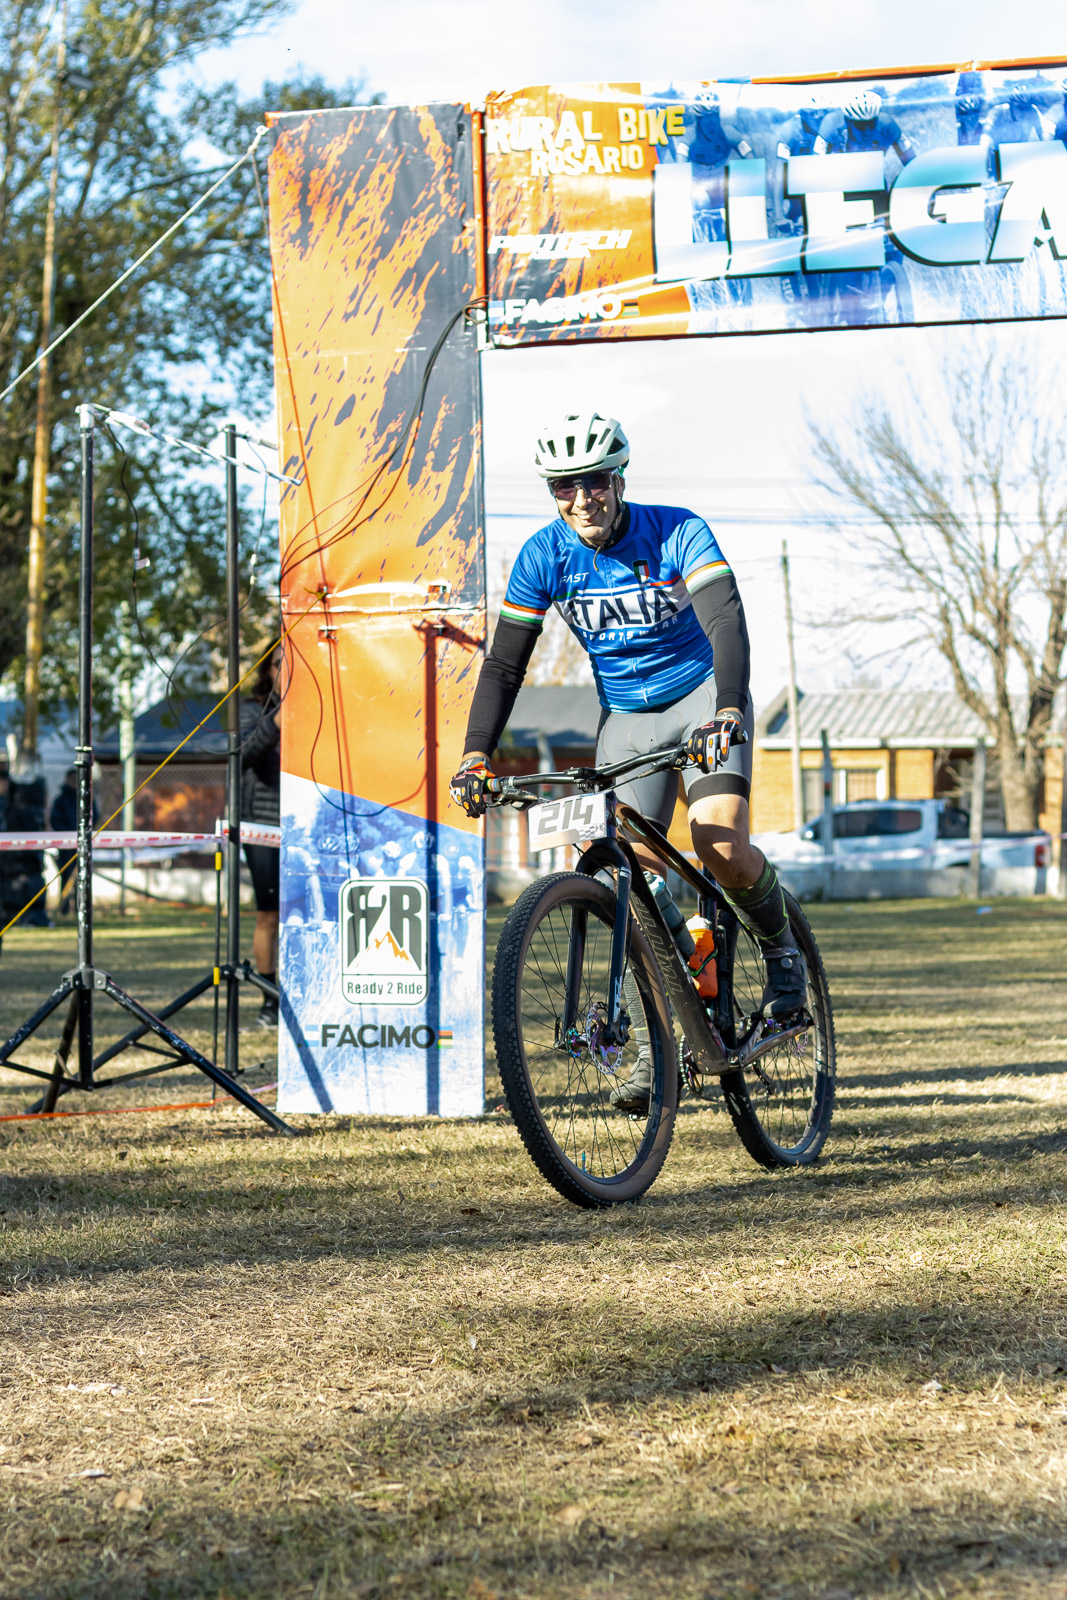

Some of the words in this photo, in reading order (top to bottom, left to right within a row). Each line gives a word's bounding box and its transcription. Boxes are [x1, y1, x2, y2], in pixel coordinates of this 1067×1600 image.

[486, 111, 602, 154] RURAL
[618, 105, 686, 146] BIKE
[530, 145, 645, 177] ROSARIO
[567, 589, 679, 630] ITALIA
[538, 798, 594, 836] 214
[347, 982, 384, 995] Ready
[387, 982, 394, 994] 2
[397, 982, 423, 994] Ride
[321, 1024, 436, 1049] FACIMO
